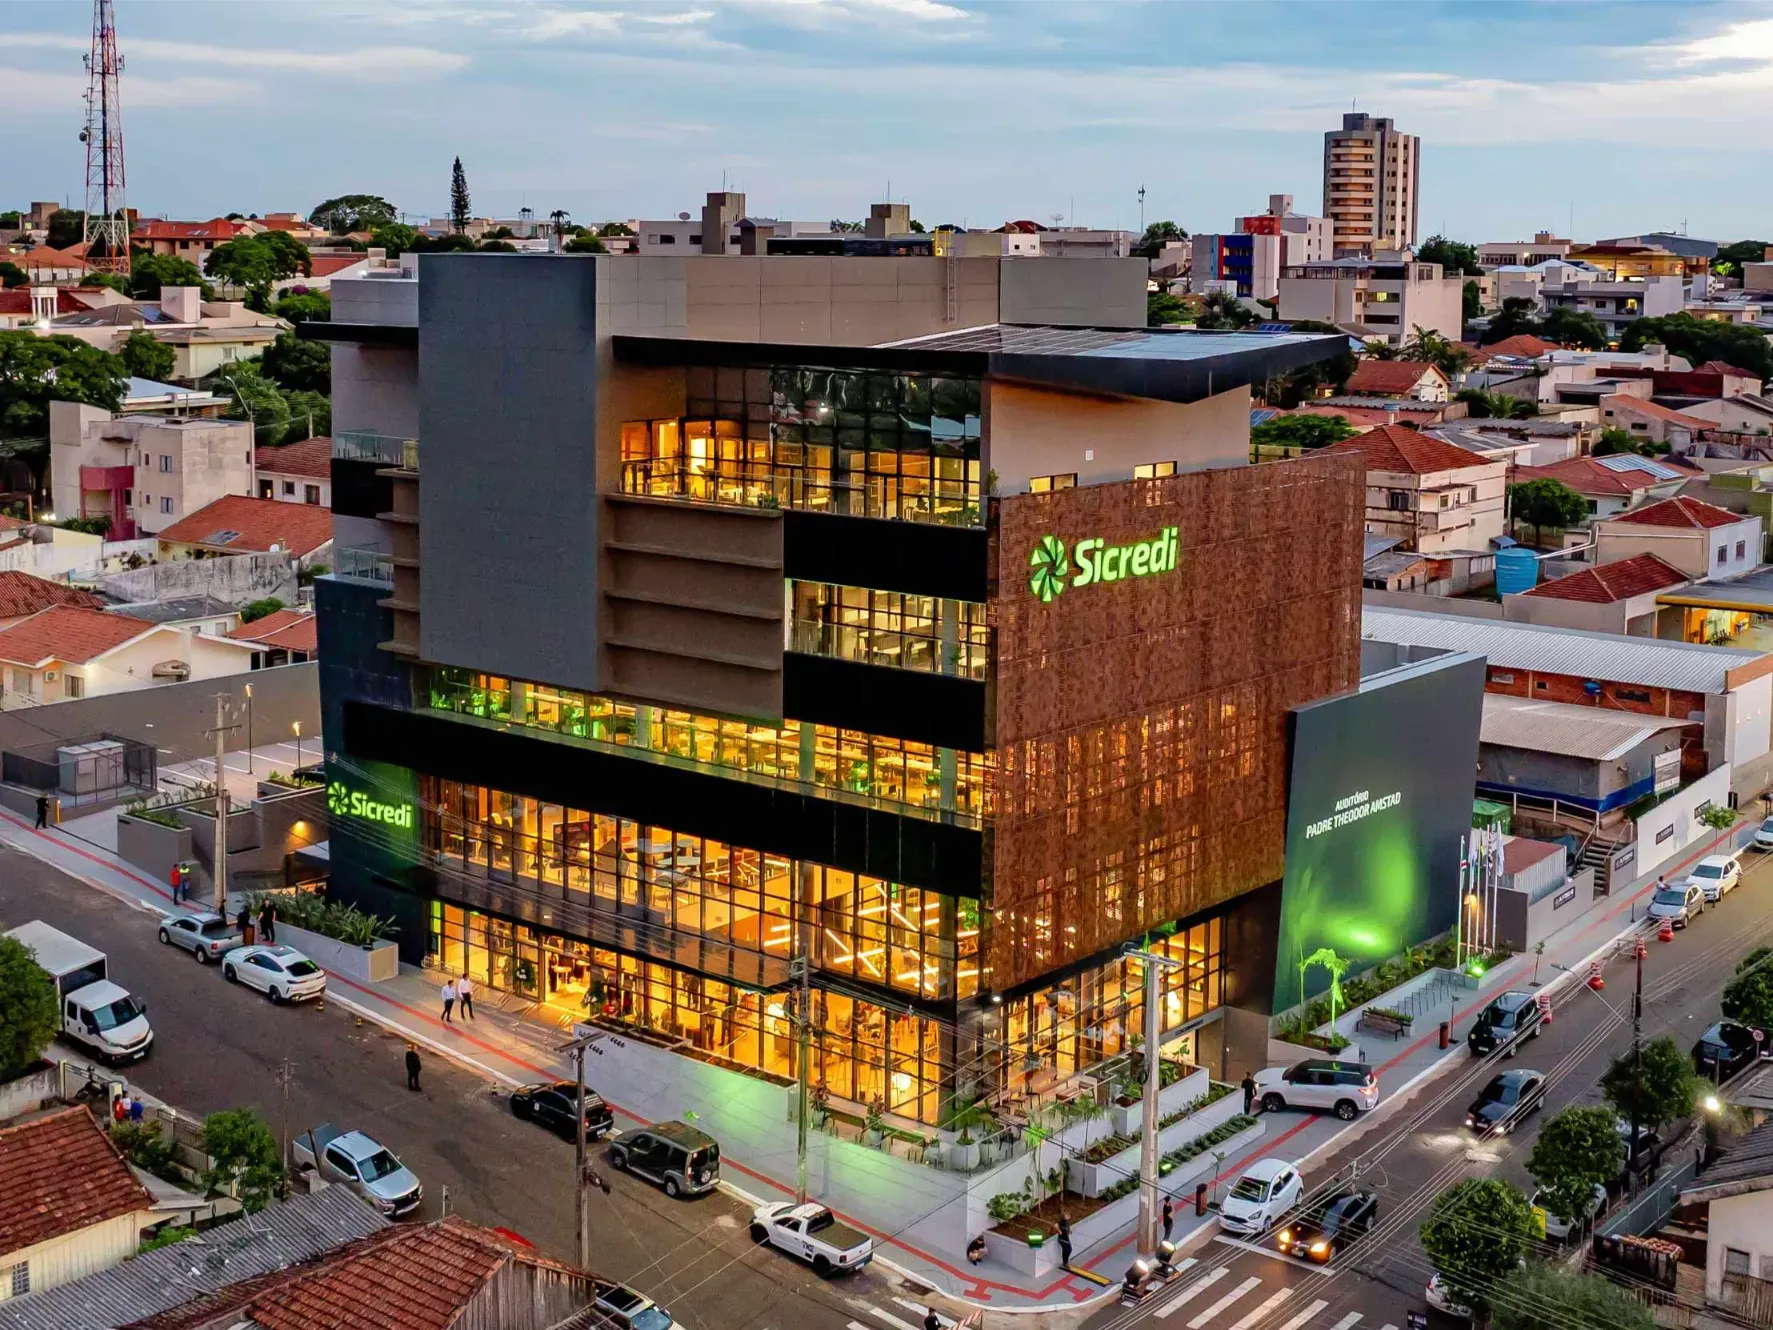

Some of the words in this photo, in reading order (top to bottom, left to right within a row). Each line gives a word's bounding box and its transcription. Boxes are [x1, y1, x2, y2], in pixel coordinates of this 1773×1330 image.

[1072, 527, 1179, 588] Sicredi
[351, 792, 412, 828] Sicredi
[1306, 817, 1334, 839] PADRE
[1334, 803, 1370, 828] THEODOR
[1370, 791, 1402, 814] AMSTAD
